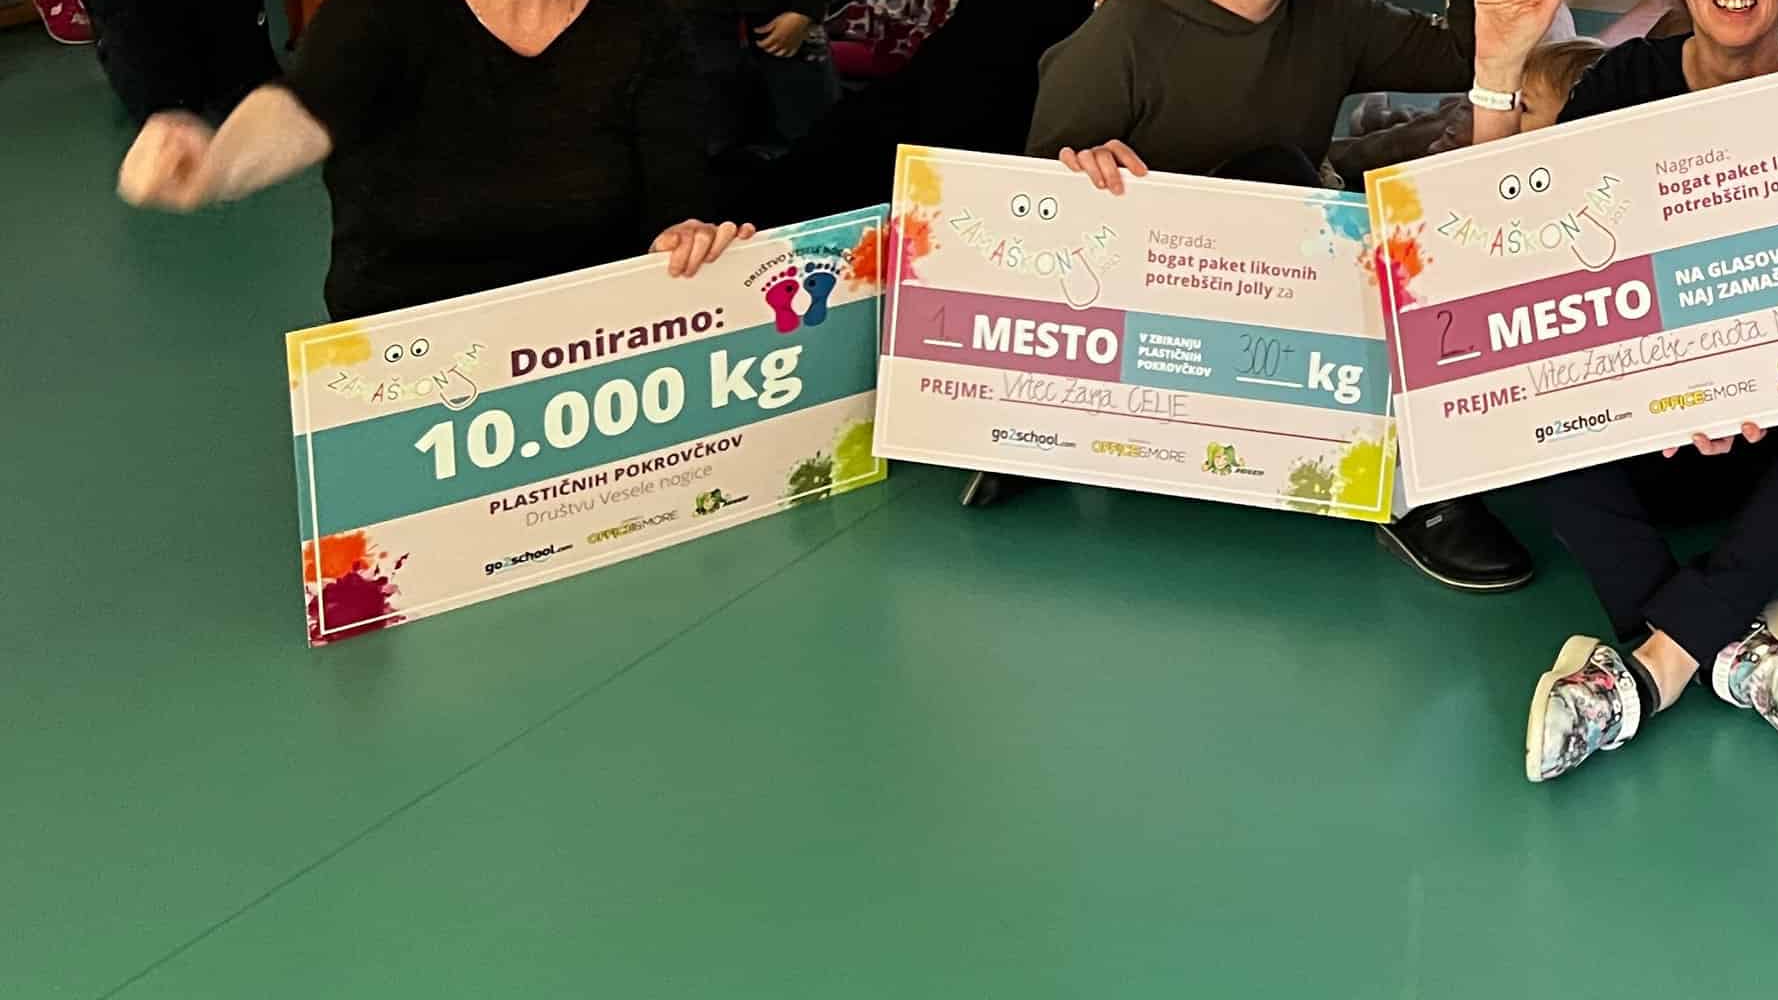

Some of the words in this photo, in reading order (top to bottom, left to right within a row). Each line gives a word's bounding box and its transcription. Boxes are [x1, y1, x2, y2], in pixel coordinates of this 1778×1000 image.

[1655, 148, 1733, 175] Nagrada:
[1658, 173, 1711, 196] bogat
[1716, 160, 1769, 188] paket
[1662, 184, 1760, 221] potrebščin
[1148, 230, 1217, 250] Nagrada:
[1147, 249, 1195, 269] bogat
[1199, 257, 1247, 272] paket
[1250, 260, 1318, 281] likovnih
[1674, 267, 1705, 287] NA
[1145, 272, 1233, 292] potrebščin
[1236, 280, 1274, 300] Jolly
[1276, 287, 1294, 299] za
[1678, 289, 1714, 309] NAJ
[1487, 280, 1652, 352] MESTO
[511, 306, 725, 378] Doniramo:
[972, 314, 1119, 365] MESTO
[1138, 332, 1149, 343] V
[1136, 359, 1212, 377] POKROVČKOV
[1137, 346, 1202, 363] PLASTIČNIH
[920, 377, 993, 400] PREJME:
[1307, 351, 1364, 404] kg
[414, 365, 685, 480] 10.000
[710, 344, 803, 410] kg
[1443, 384, 1528, 419] PREJME:
[490, 472, 608, 515] PLASTIČNIH
[614, 434, 744, 482] POKROVČKOV
[526, 498, 595, 528] Društvu
[599, 480, 656, 506] Vesele
[659, 463, 713, 489] nogice
